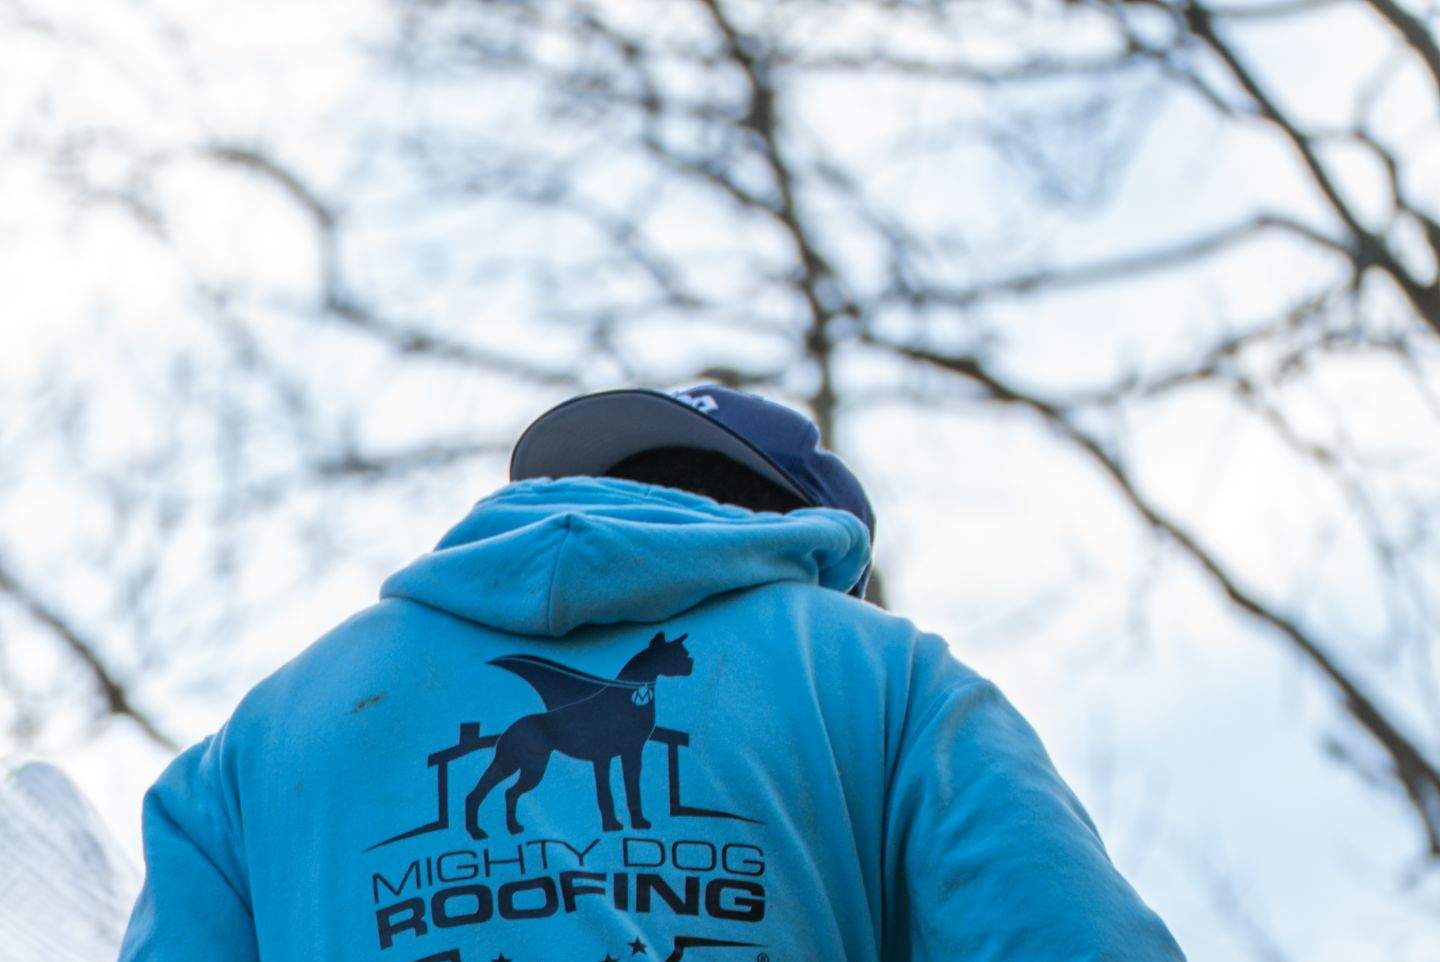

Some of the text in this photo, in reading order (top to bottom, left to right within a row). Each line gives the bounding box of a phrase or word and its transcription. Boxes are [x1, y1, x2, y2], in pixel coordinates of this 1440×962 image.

[371, 836, 766, 904] MIGHTY DOG
[374, 870, 767, 951] ROOFING
